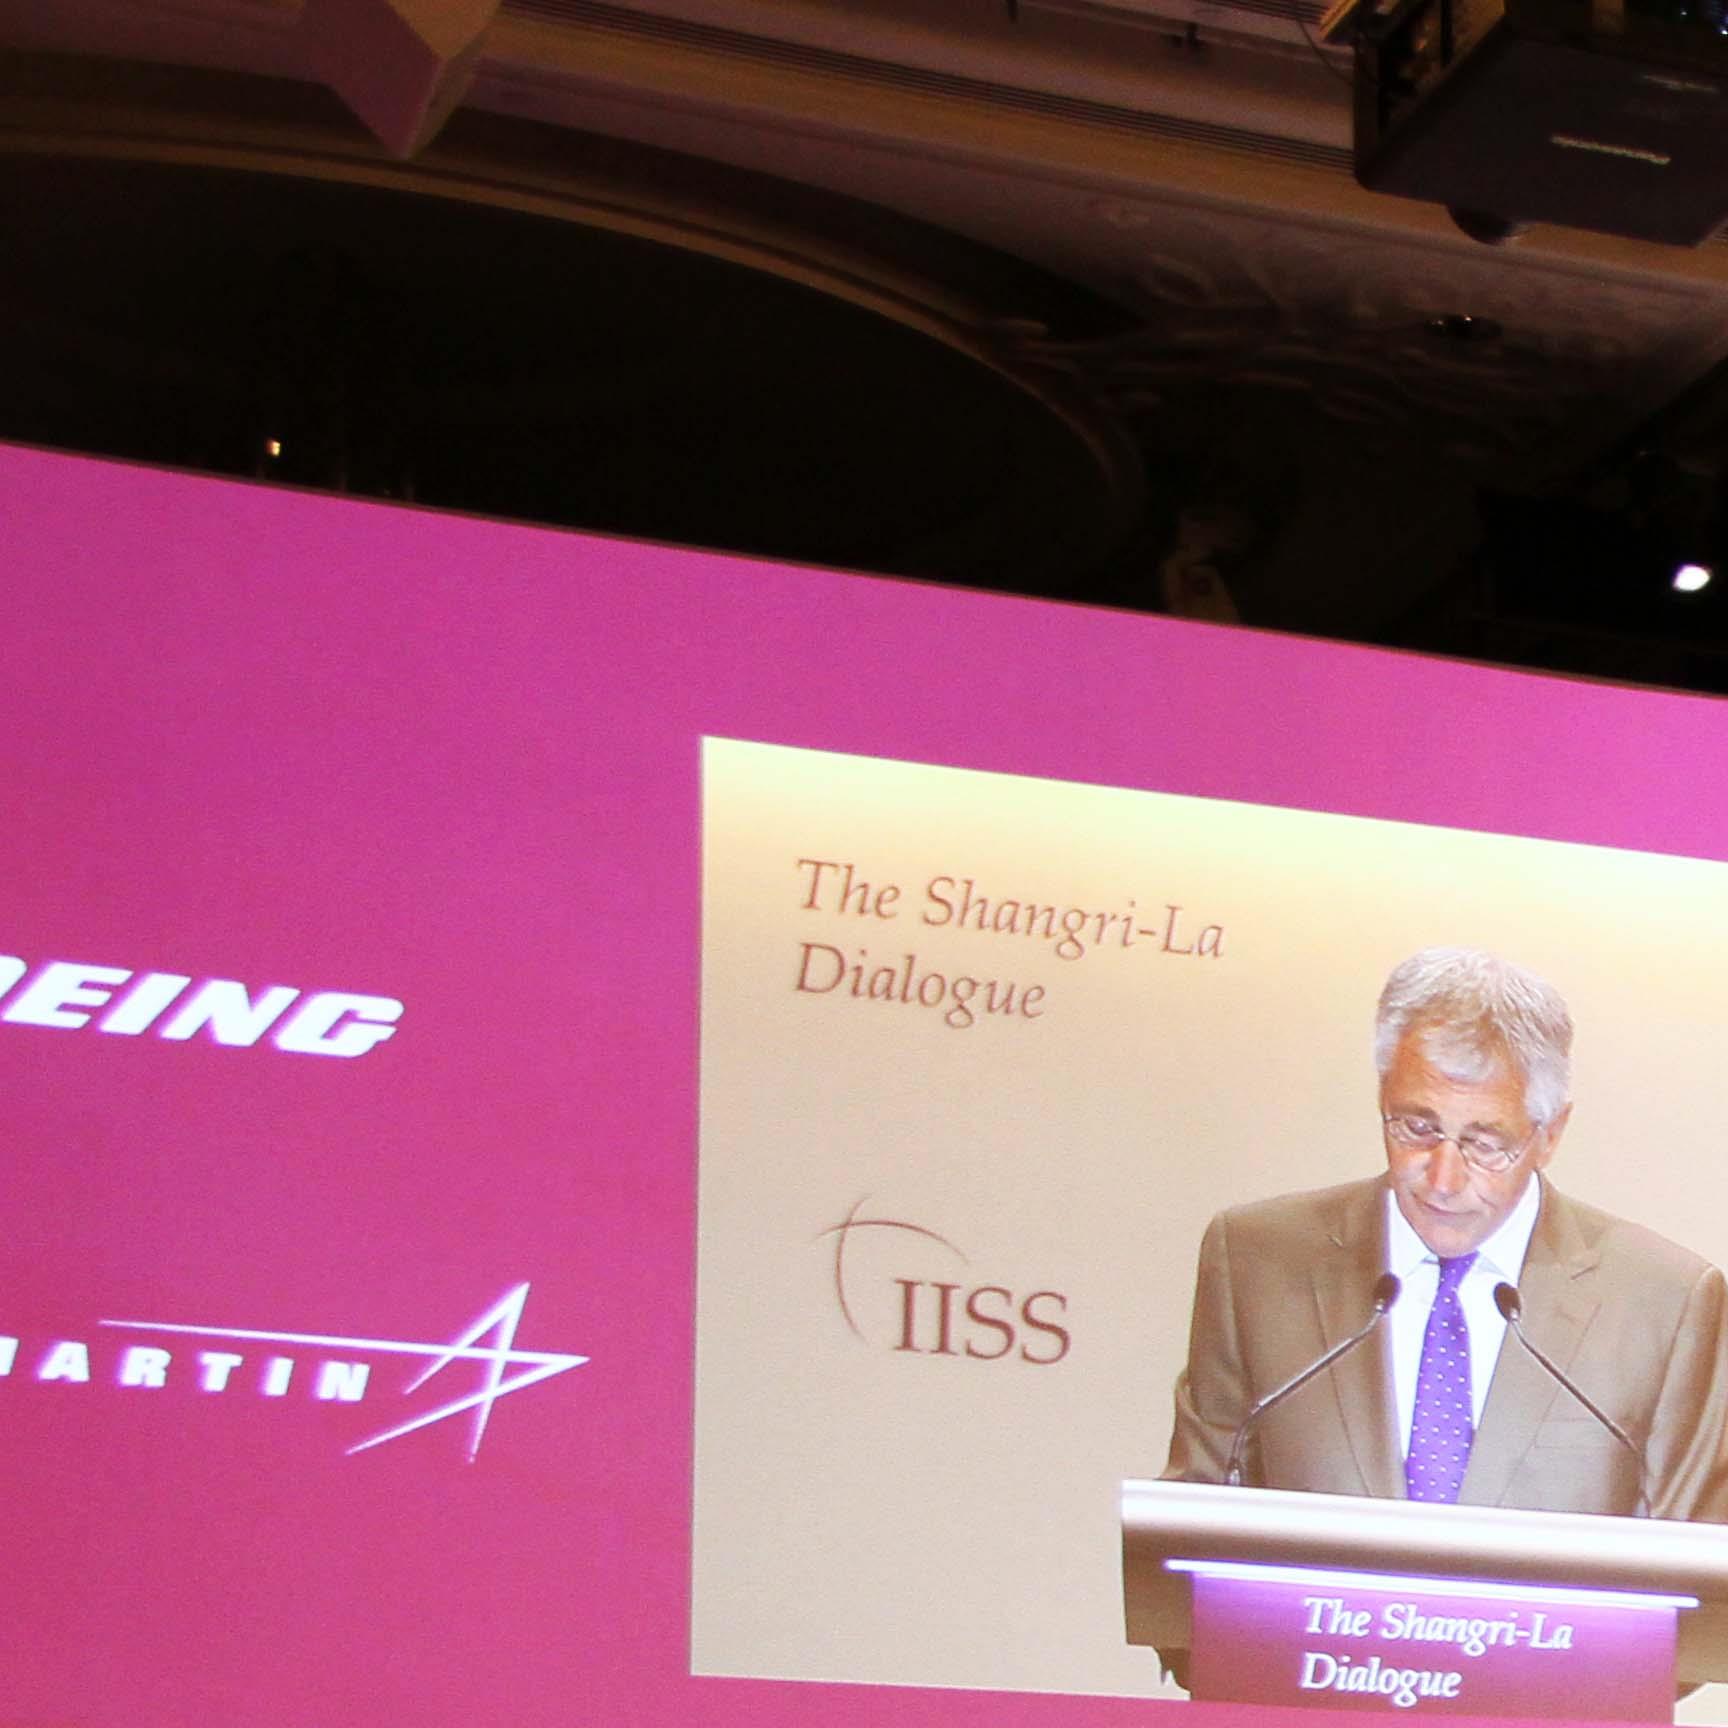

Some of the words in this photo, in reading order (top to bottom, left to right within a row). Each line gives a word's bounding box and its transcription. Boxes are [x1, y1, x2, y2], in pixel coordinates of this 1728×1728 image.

[798, 858, 900, 919] The
[922, 876, 1225, 961] Shangri-La
[795, 943, 1046, 1029] Dialogue
[893, 1278, 1072, 1365] IISS
[1304, 1597, 1372, 1639] The
[1380, 1602, 1574, 1656] Shangri-La
[1301, 1654, 1463, 1707] Dialogue
